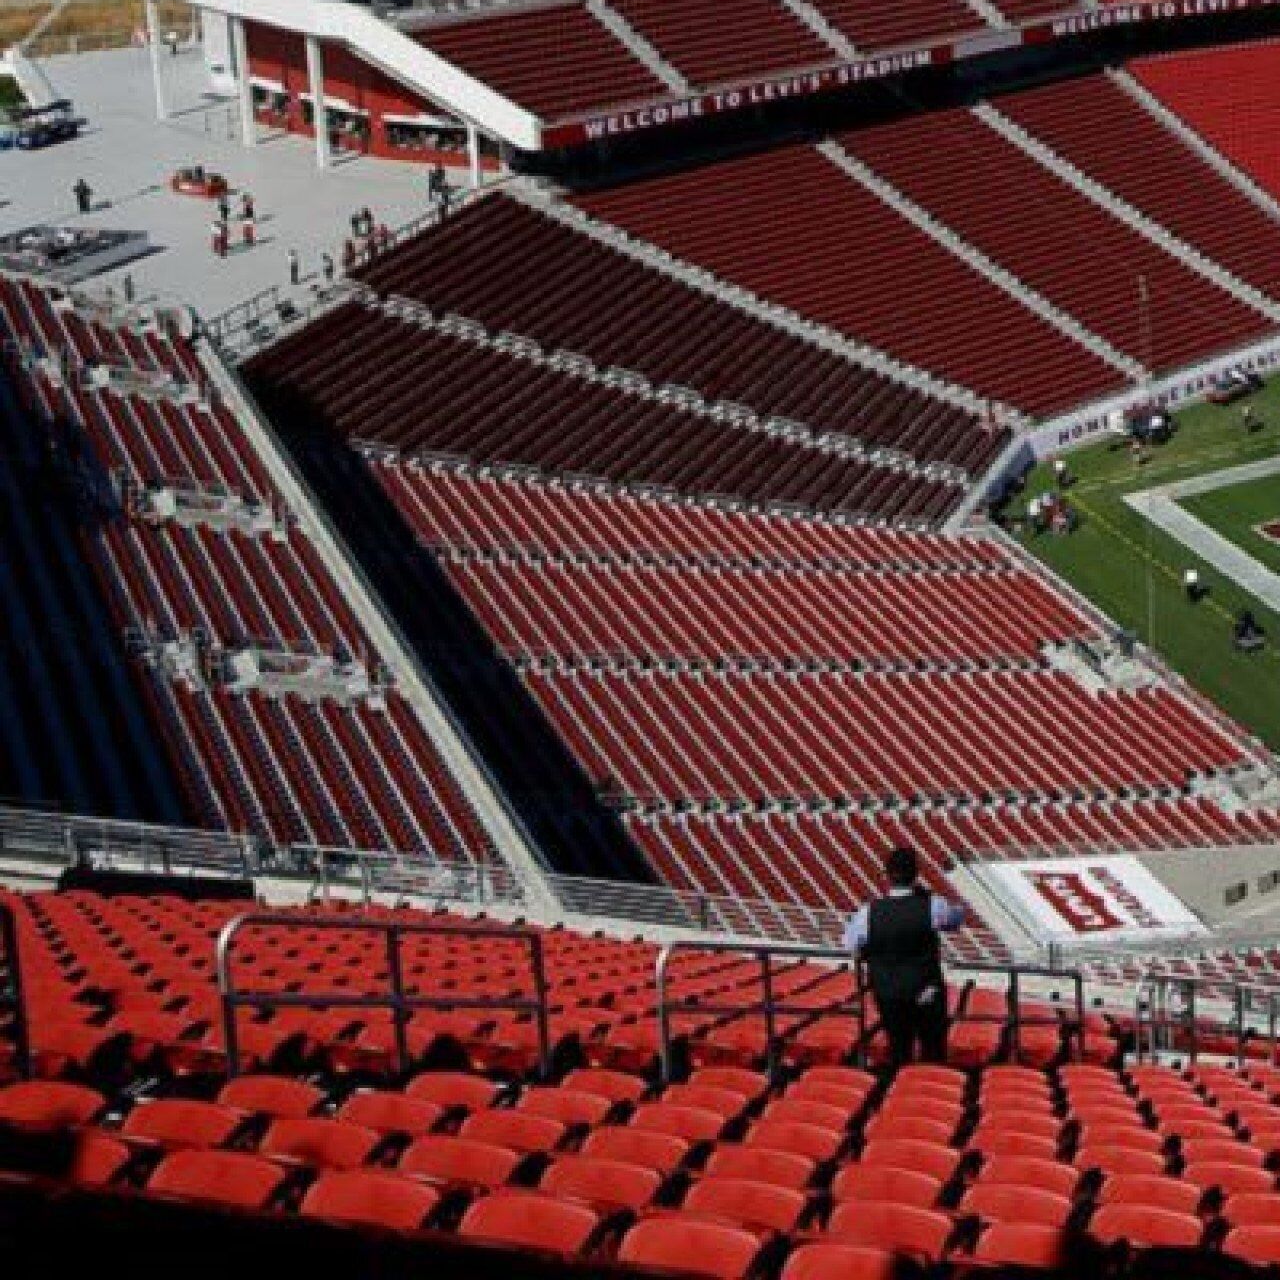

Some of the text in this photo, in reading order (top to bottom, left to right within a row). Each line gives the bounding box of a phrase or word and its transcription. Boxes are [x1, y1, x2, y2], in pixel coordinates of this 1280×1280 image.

[585, 100, 702, 139] WELCOME
[714, 93, 741, 111] TO
[837, 49, 931, 84] STADIUM
